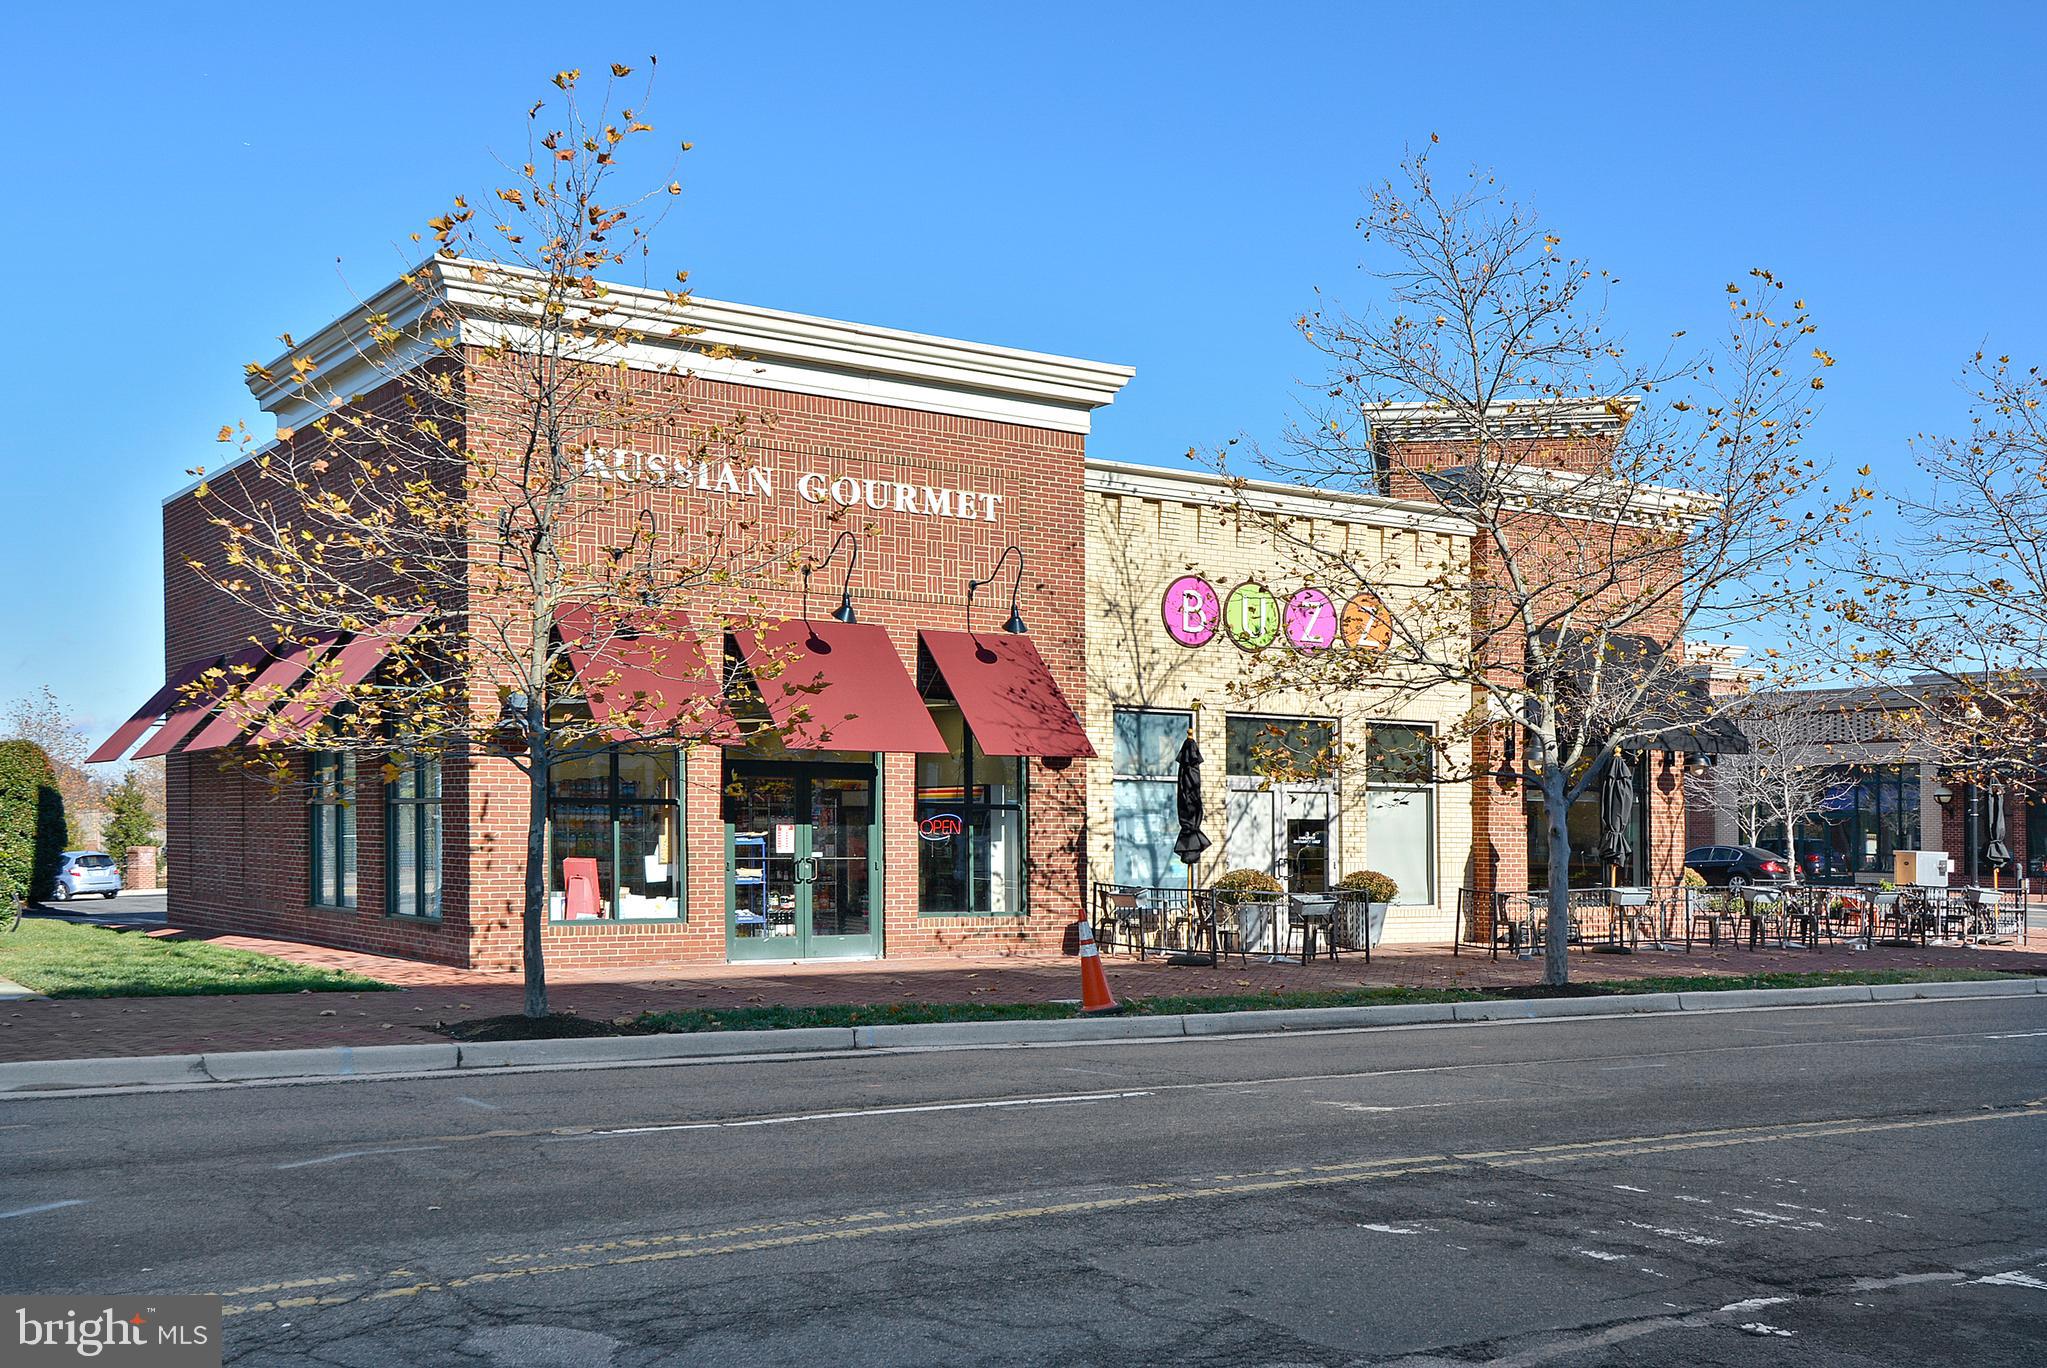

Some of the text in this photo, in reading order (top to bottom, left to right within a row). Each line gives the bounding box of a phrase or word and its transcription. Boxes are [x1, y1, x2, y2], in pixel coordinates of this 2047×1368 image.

[583, 447, 1003, 523] RUSSIAN GOURMET
[1182, 589, 1379, 648] BUZZ
[920, 819, 962, 835] OPEN
